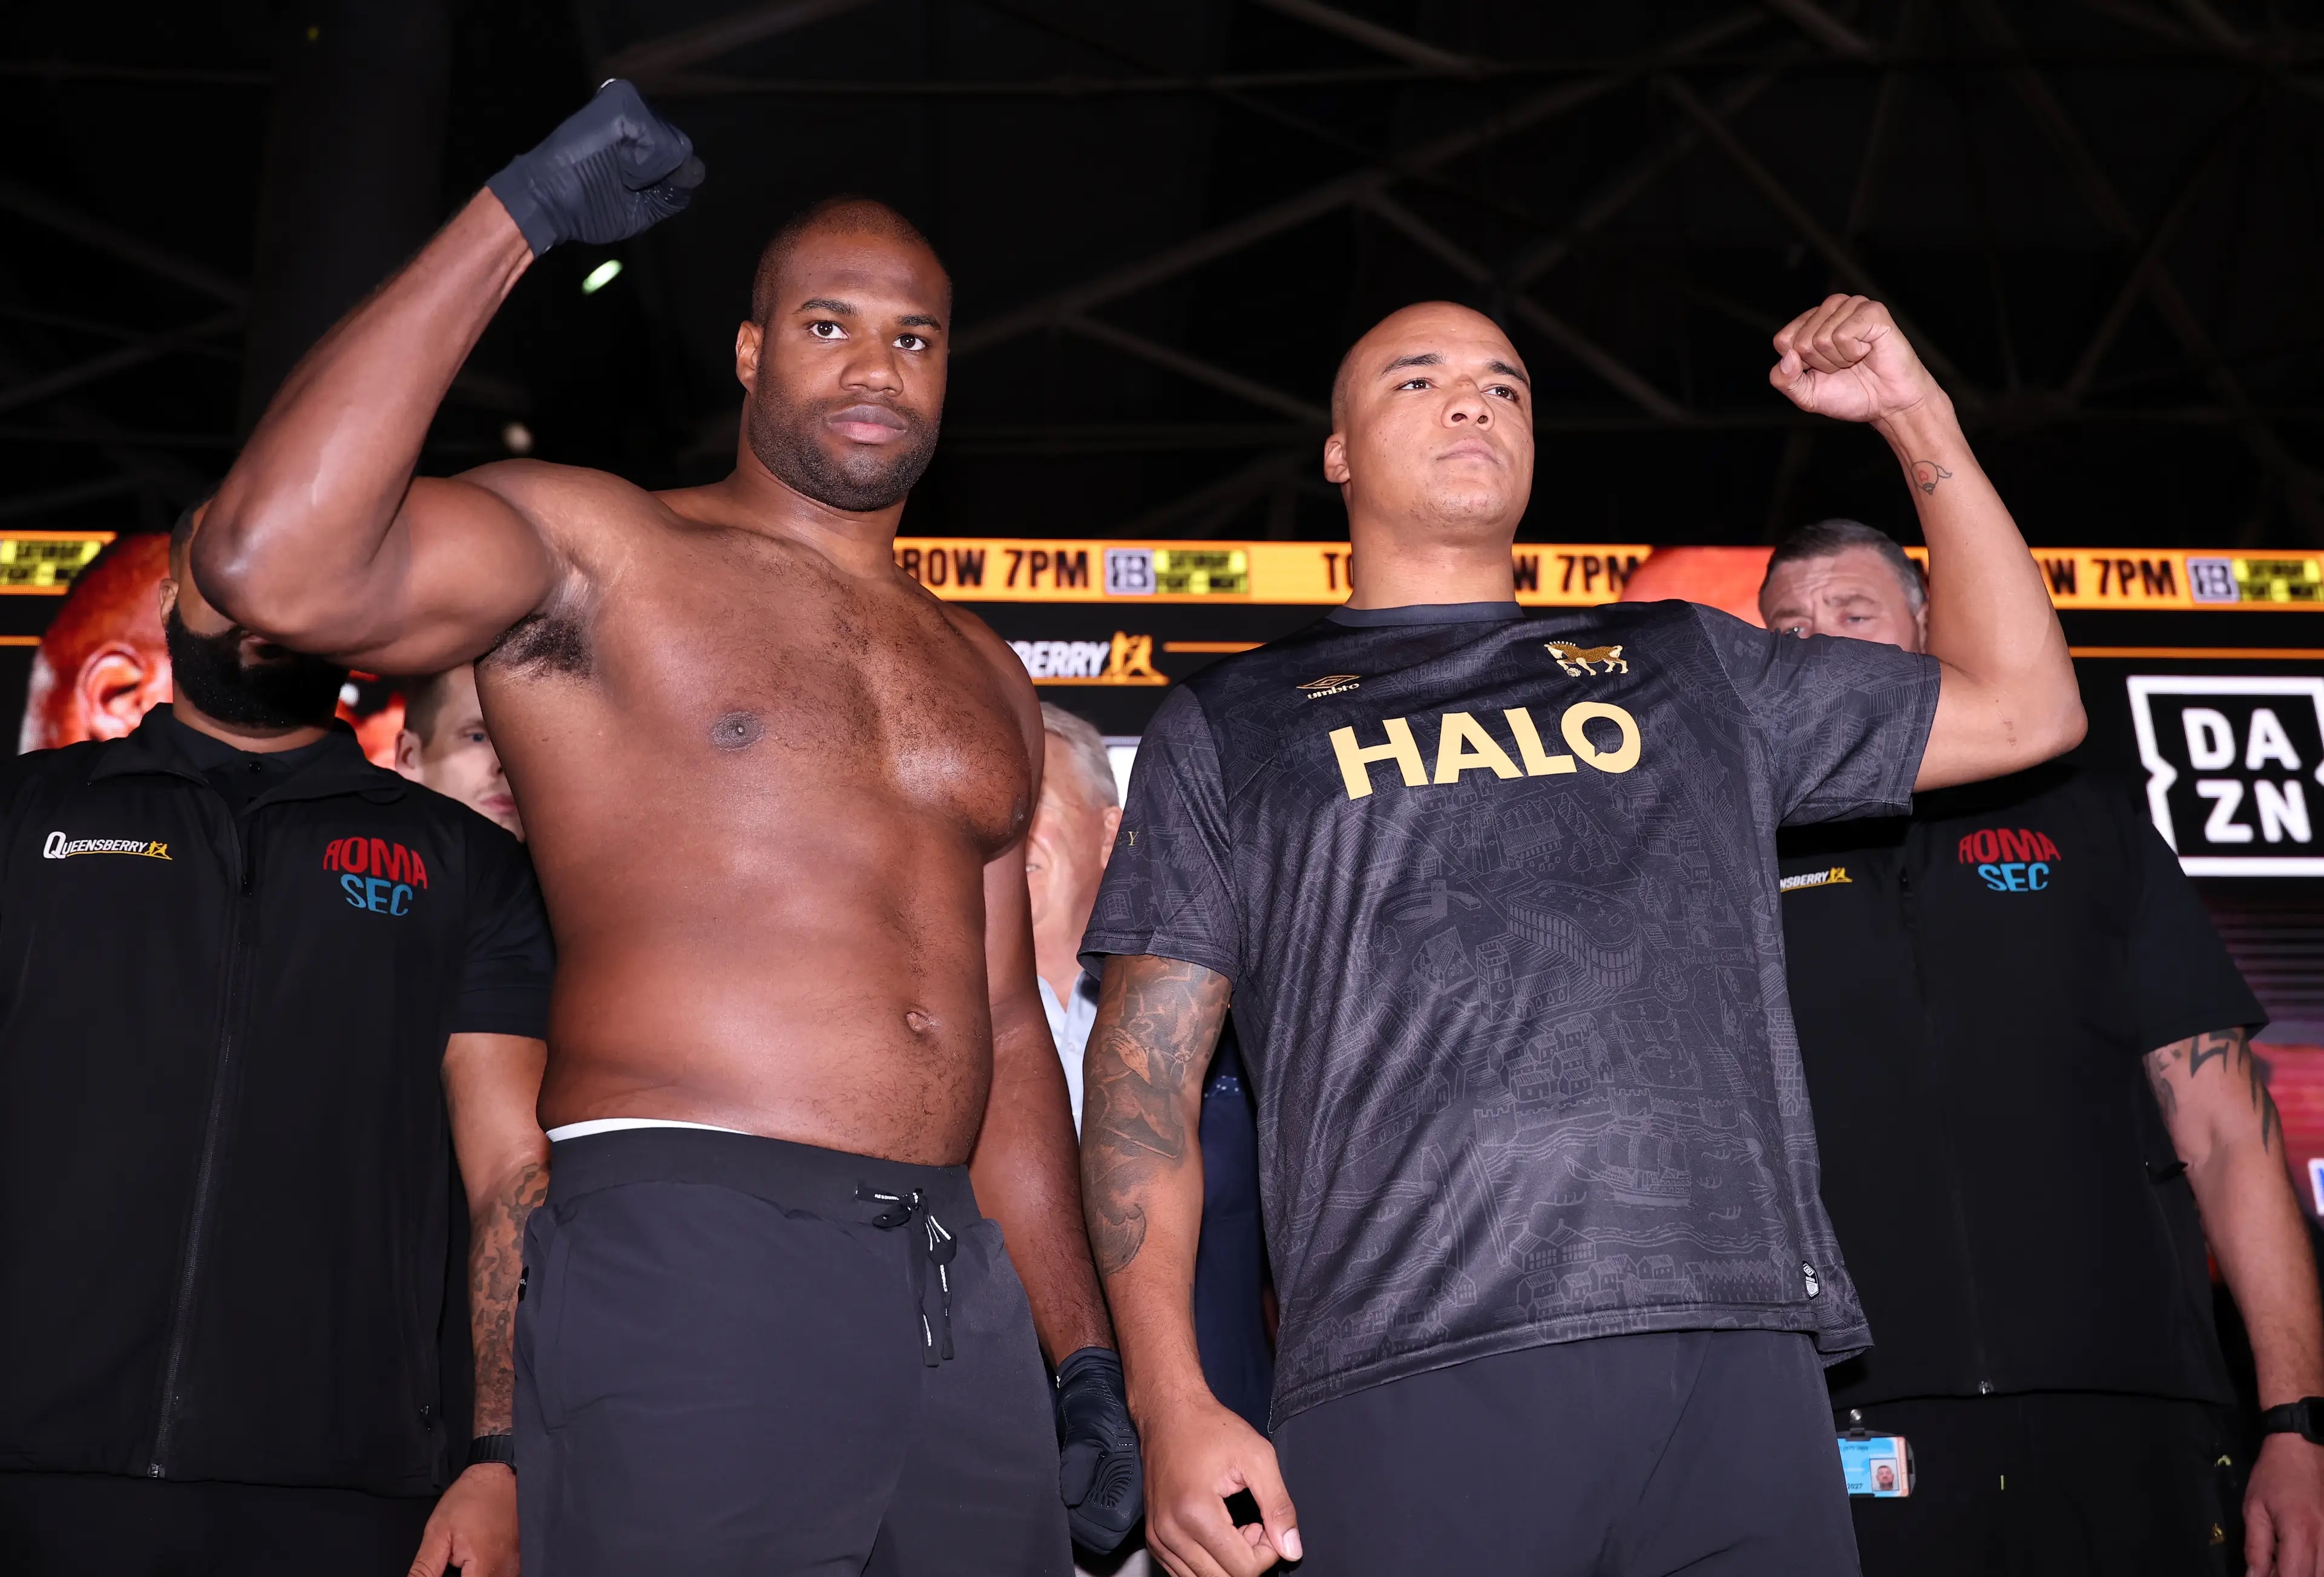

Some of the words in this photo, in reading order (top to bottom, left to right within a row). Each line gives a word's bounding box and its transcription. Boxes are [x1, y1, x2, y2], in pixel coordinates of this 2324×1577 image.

[1003, 550, 1088, 588] 7PM
[2092, 558, 2178, 596] 7PM
[1307, 683, 1360, 699] umbro
[1328, 701, 1641, 800] HALO
[2181, 708, 2301, 771] DA
[2196, 780, 2312, 843] ZN
[43, 831, 149, 859] QUEENSBERRY
[340, 874, 413, 917] SEC
[1780, 871, 1830, 889] NSBERRY
[1977, 862, 2050, 892] SEC
